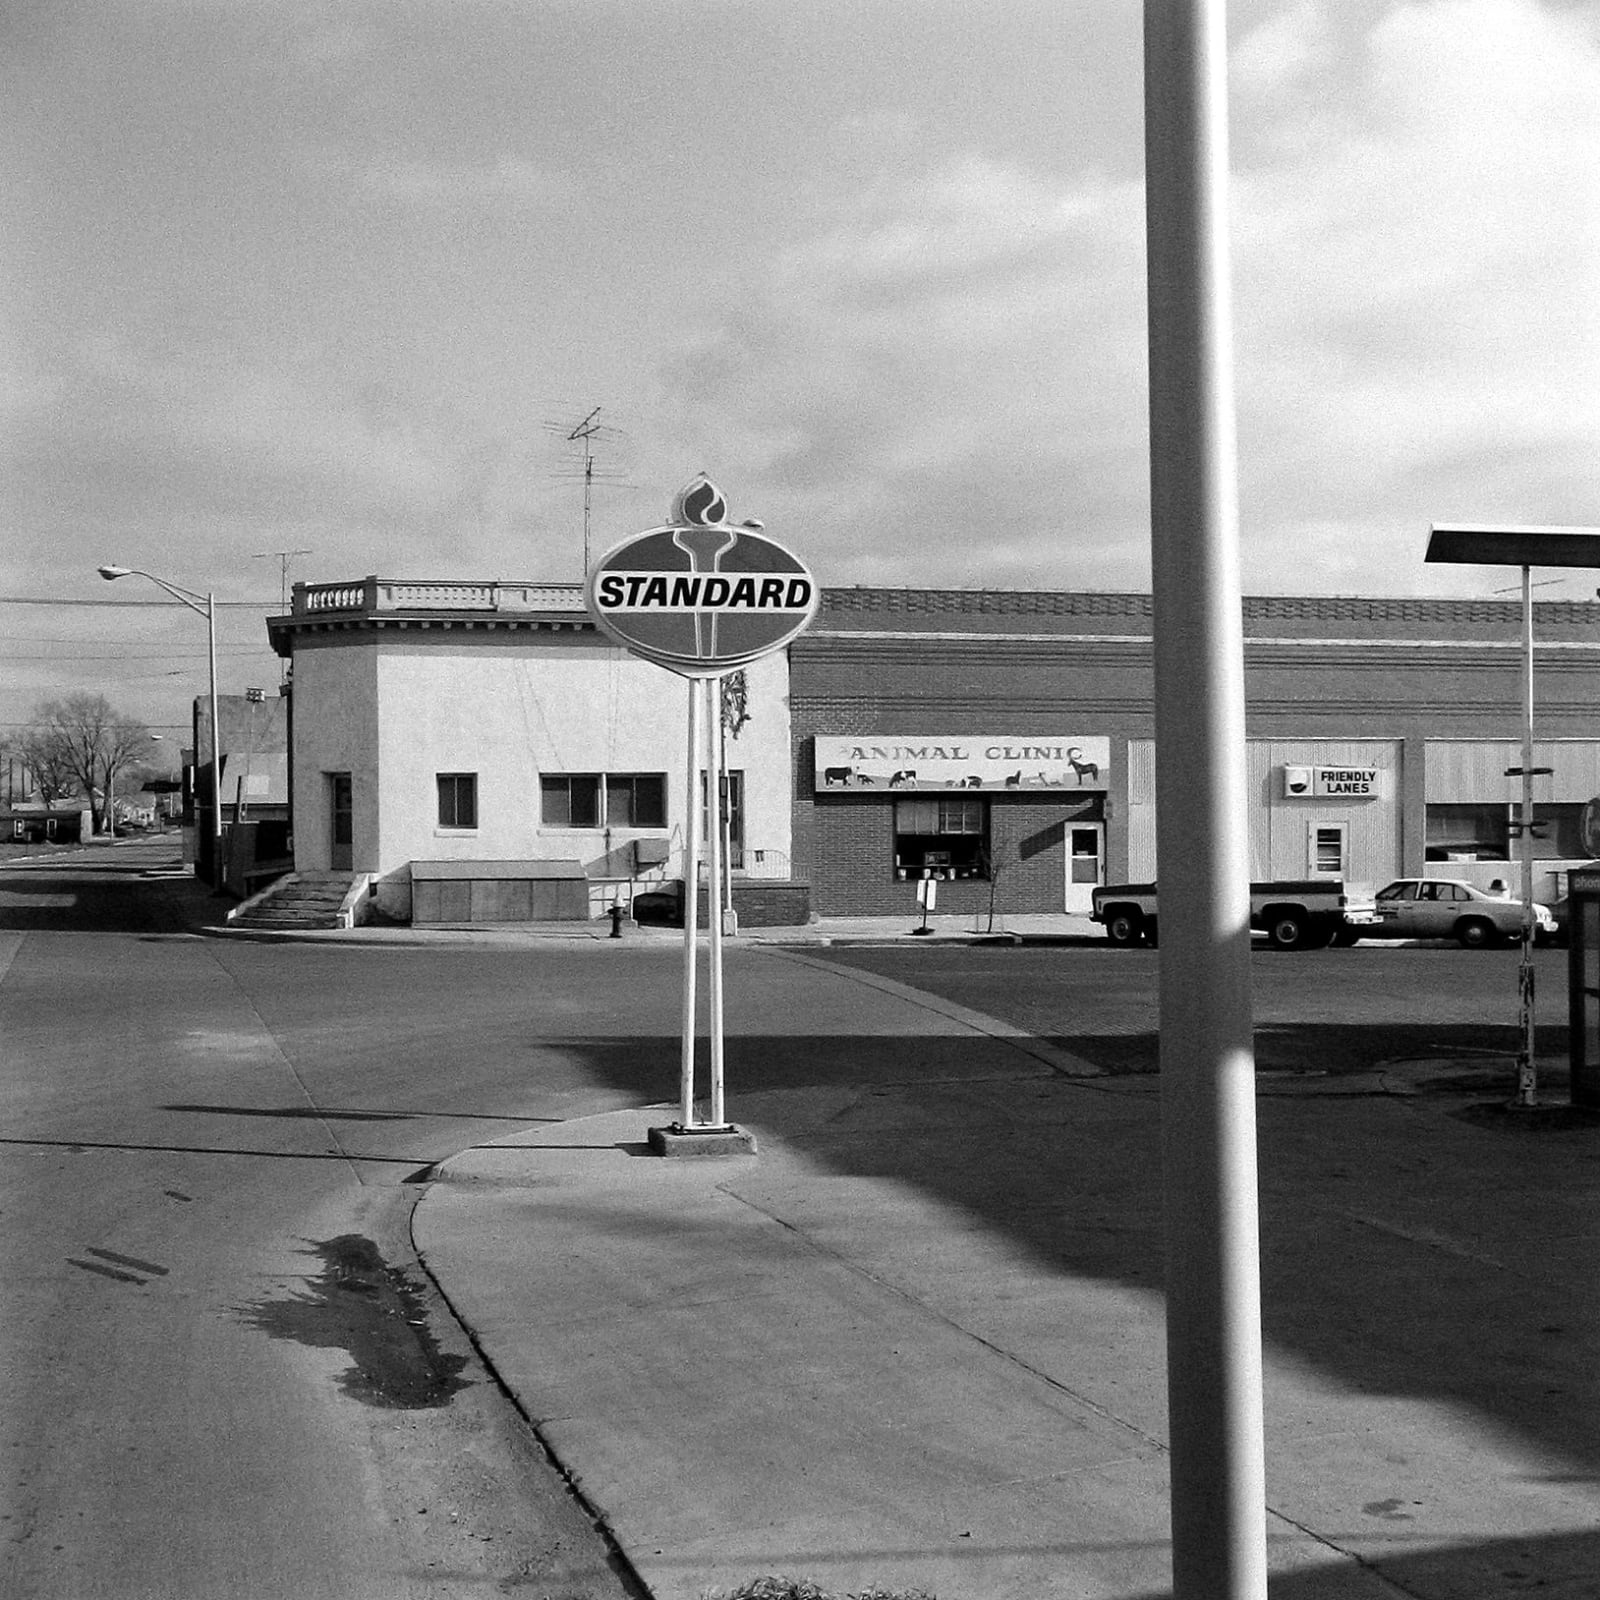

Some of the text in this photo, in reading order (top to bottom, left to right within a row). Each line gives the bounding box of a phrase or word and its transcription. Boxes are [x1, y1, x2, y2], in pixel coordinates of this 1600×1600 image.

[598, 575, 812, 608] STANDARD
[850, 746, 1083, 760] ANIMAL CLINIC
[1320, 771, 1376, 782] FRIENDLY
[1326, 782, 1370, 794] LANES
